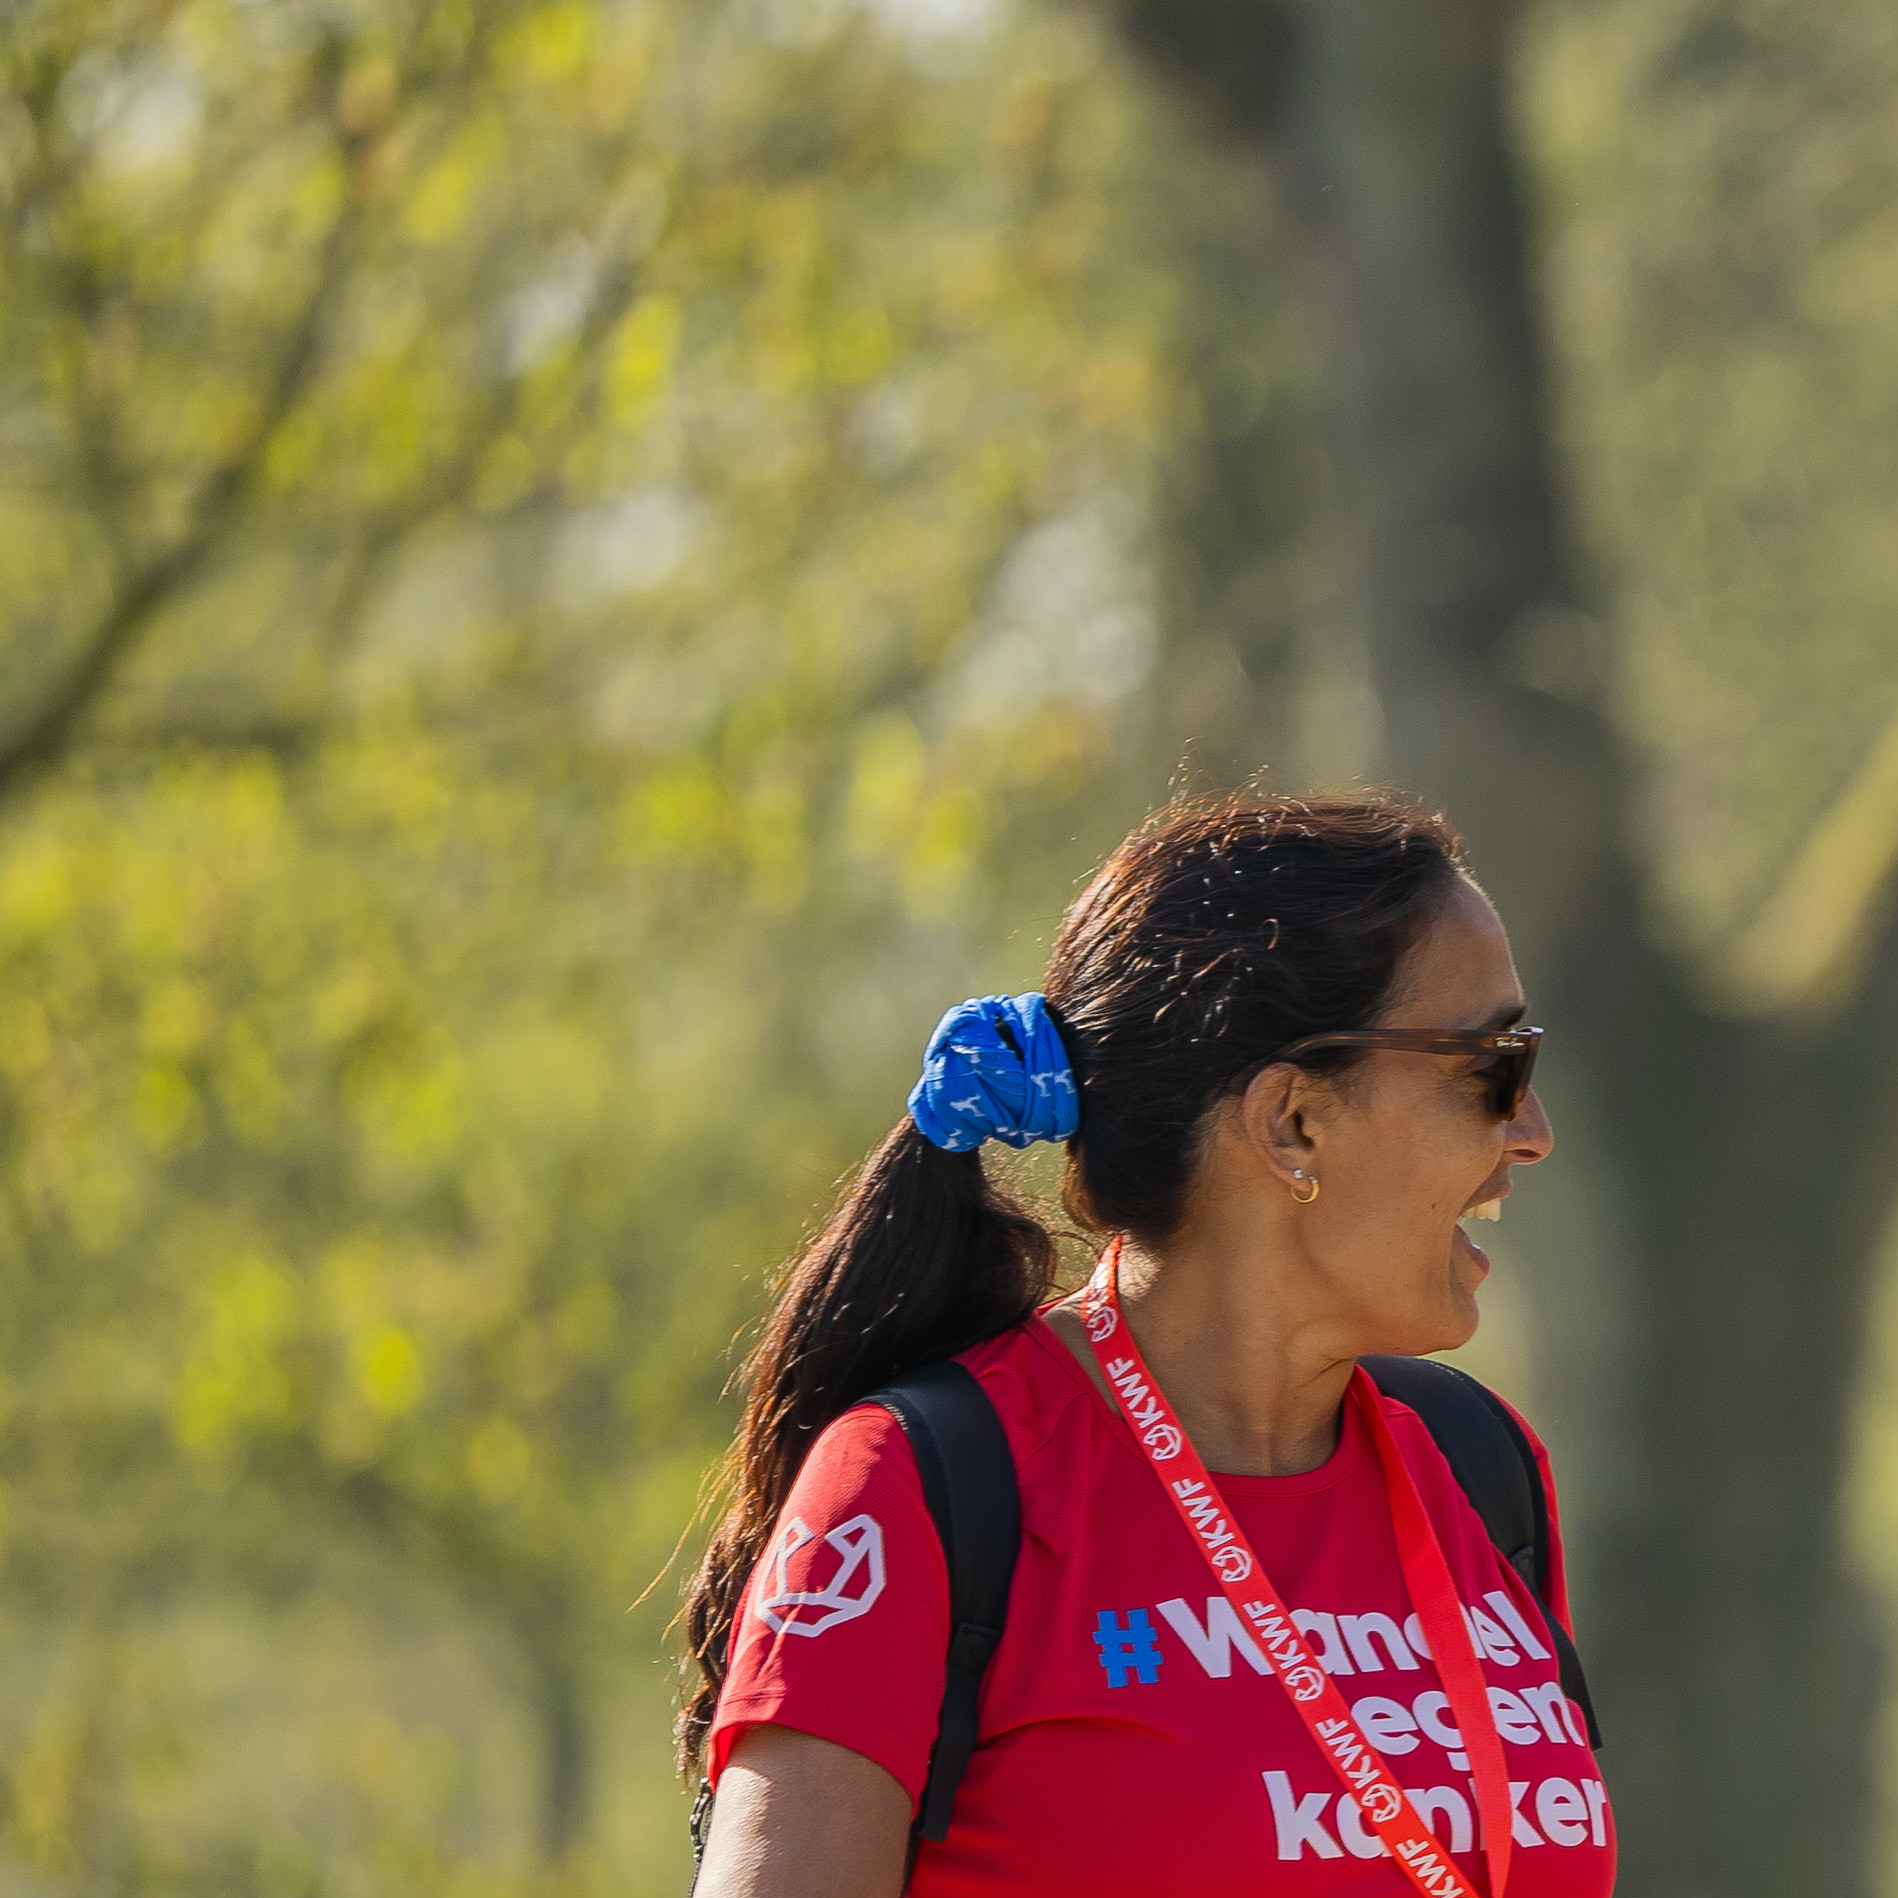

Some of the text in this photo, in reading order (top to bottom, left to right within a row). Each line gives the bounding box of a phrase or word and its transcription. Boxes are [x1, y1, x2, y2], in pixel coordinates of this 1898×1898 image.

[1106, 1356, 1164, 1429] KWF
[1171, 1477, 1236, 1550] KWF
[1242, 1599, 1307, 1671] KWF
[1314, 1716, 1382, 1790] KWF
[1350, 1681, 1585, 1773] egen
